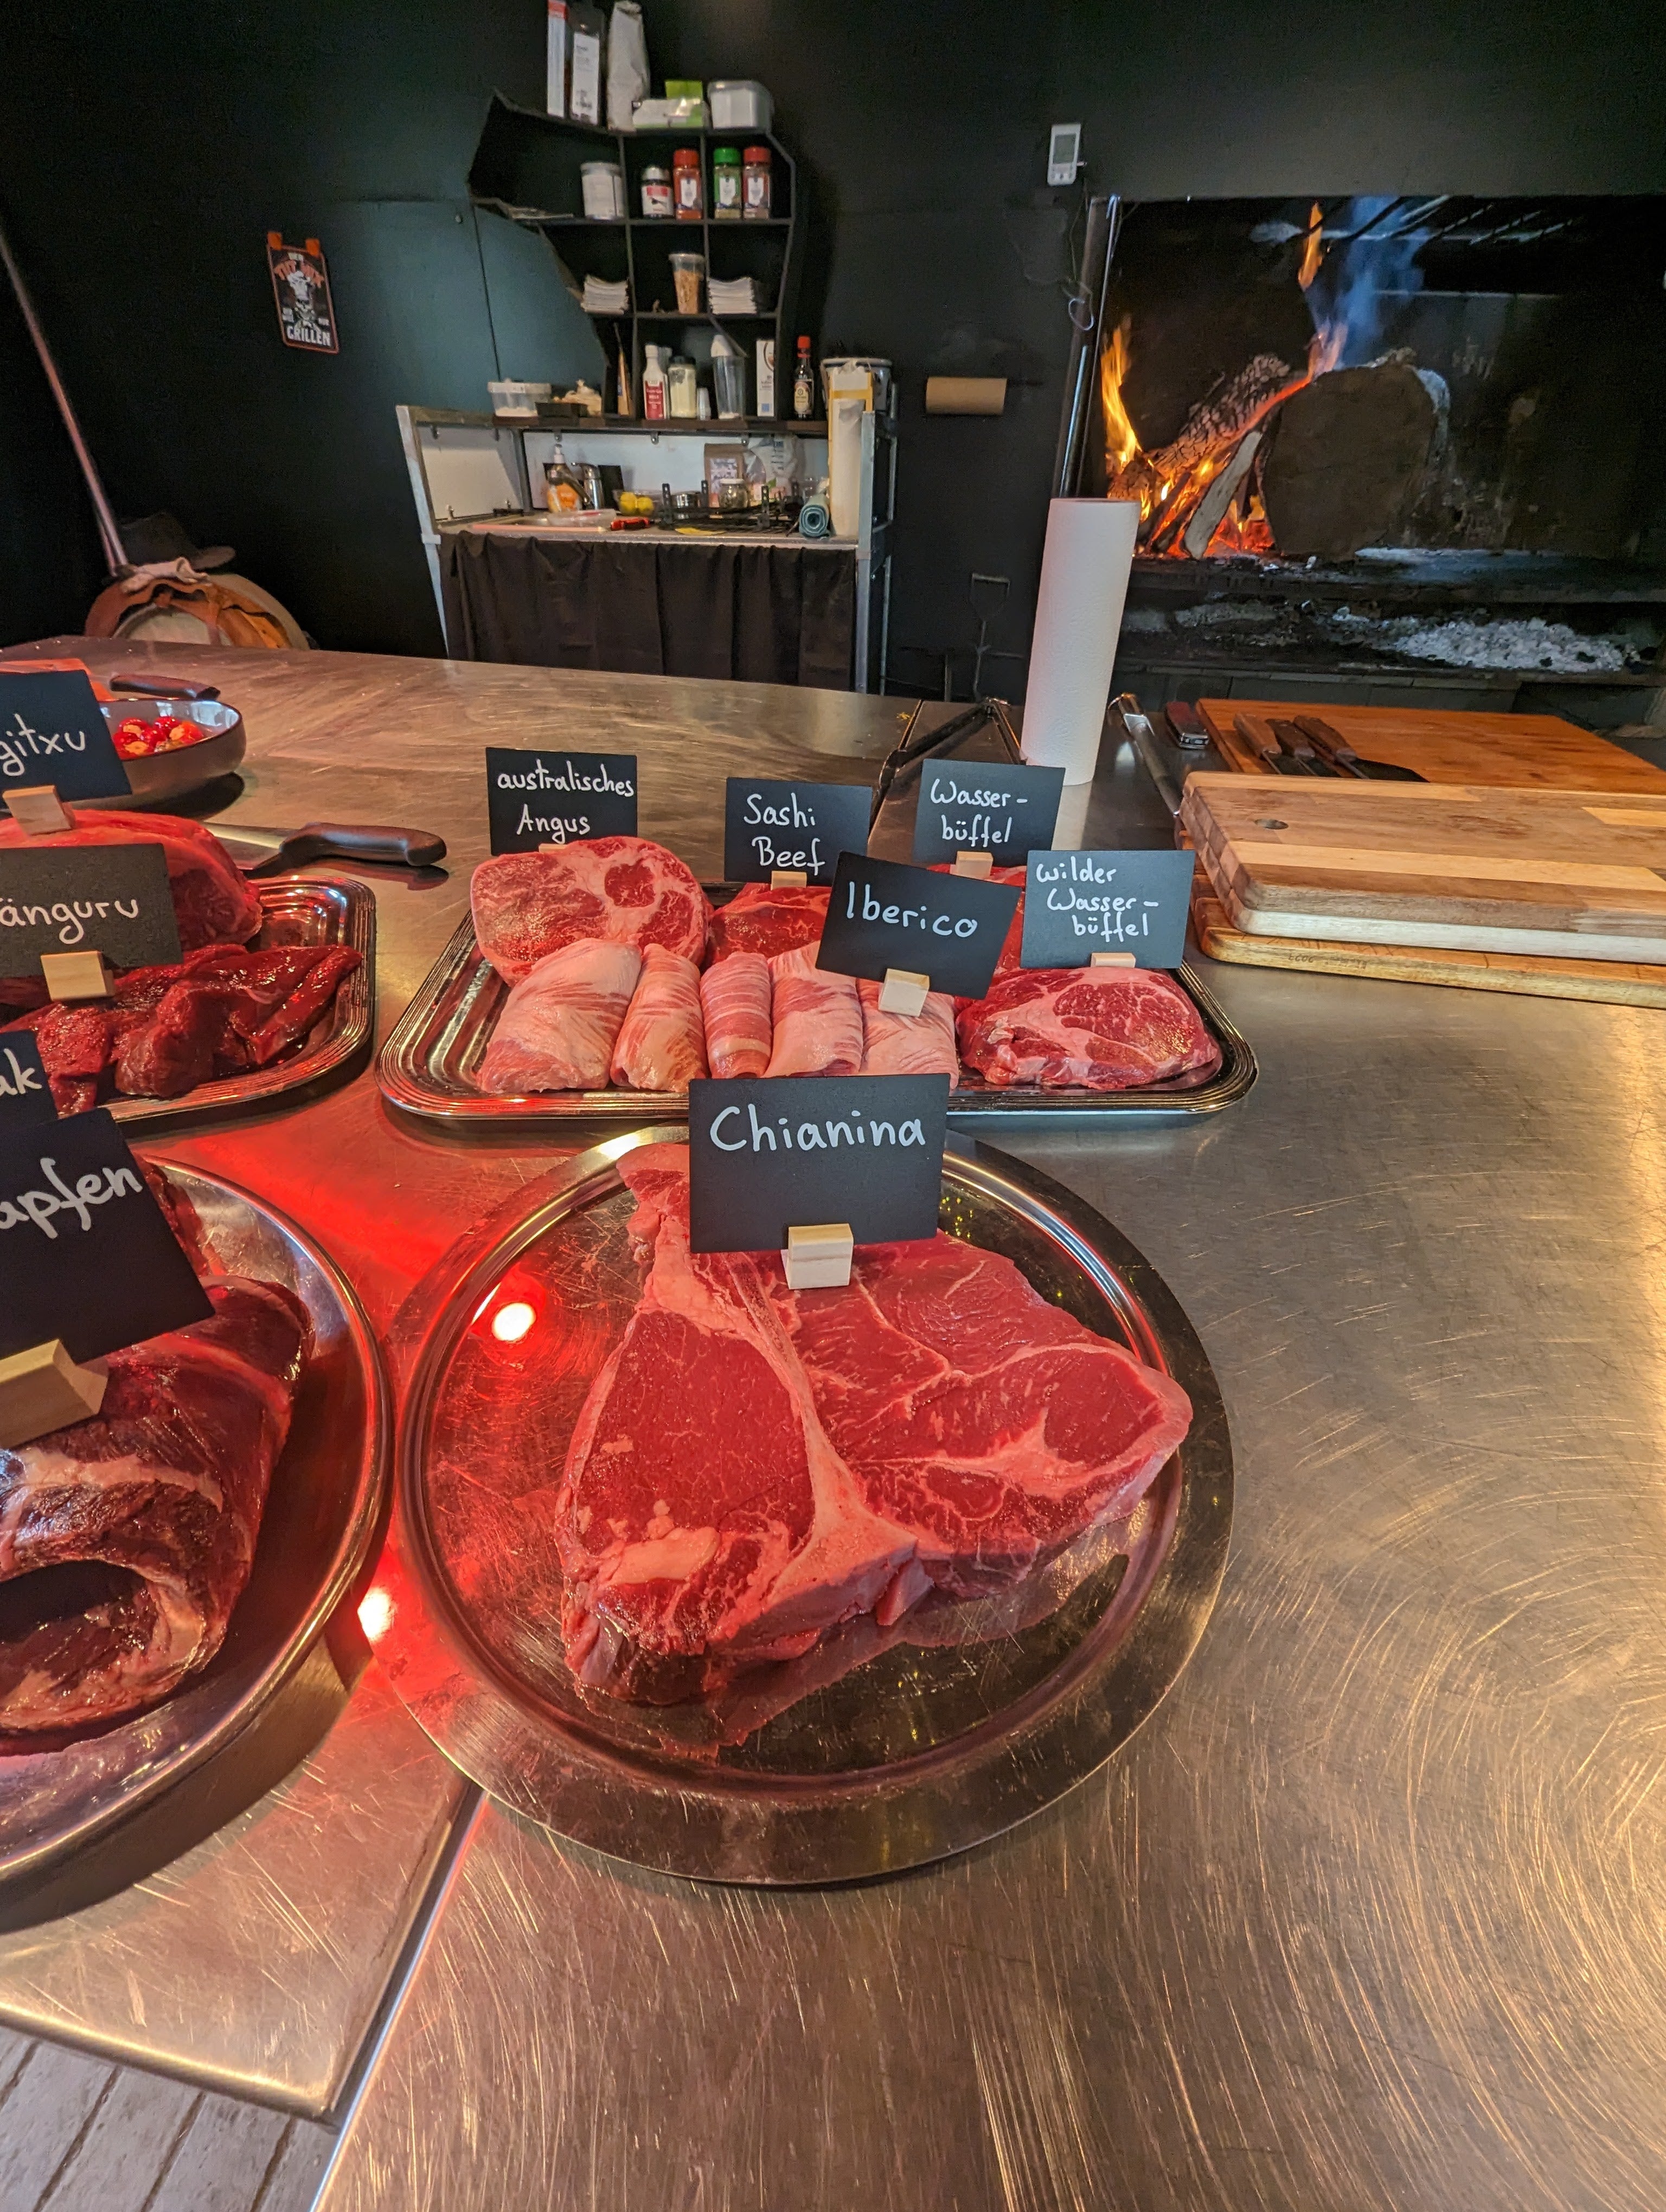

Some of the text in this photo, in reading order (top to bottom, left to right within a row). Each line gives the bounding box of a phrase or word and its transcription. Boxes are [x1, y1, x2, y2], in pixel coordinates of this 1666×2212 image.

[497, 758, 634, 797] australisches
[930, 778, 1028, 808] Wasser-
[516, 803, 591, 845] Angus
[744, 792, 816, 828] Sashi
[941, 814, 1012, 847] büffel
[752, 838, 825, 876] Beef
[847, 881, 978, 937] Iberico
[1047, 888, 1159, 912] Wasser-
[0, 897, 139, 944] änguru
[1072, 911, 1149, 942] büffel
[710, 1103, 926, 1152] Chianina
